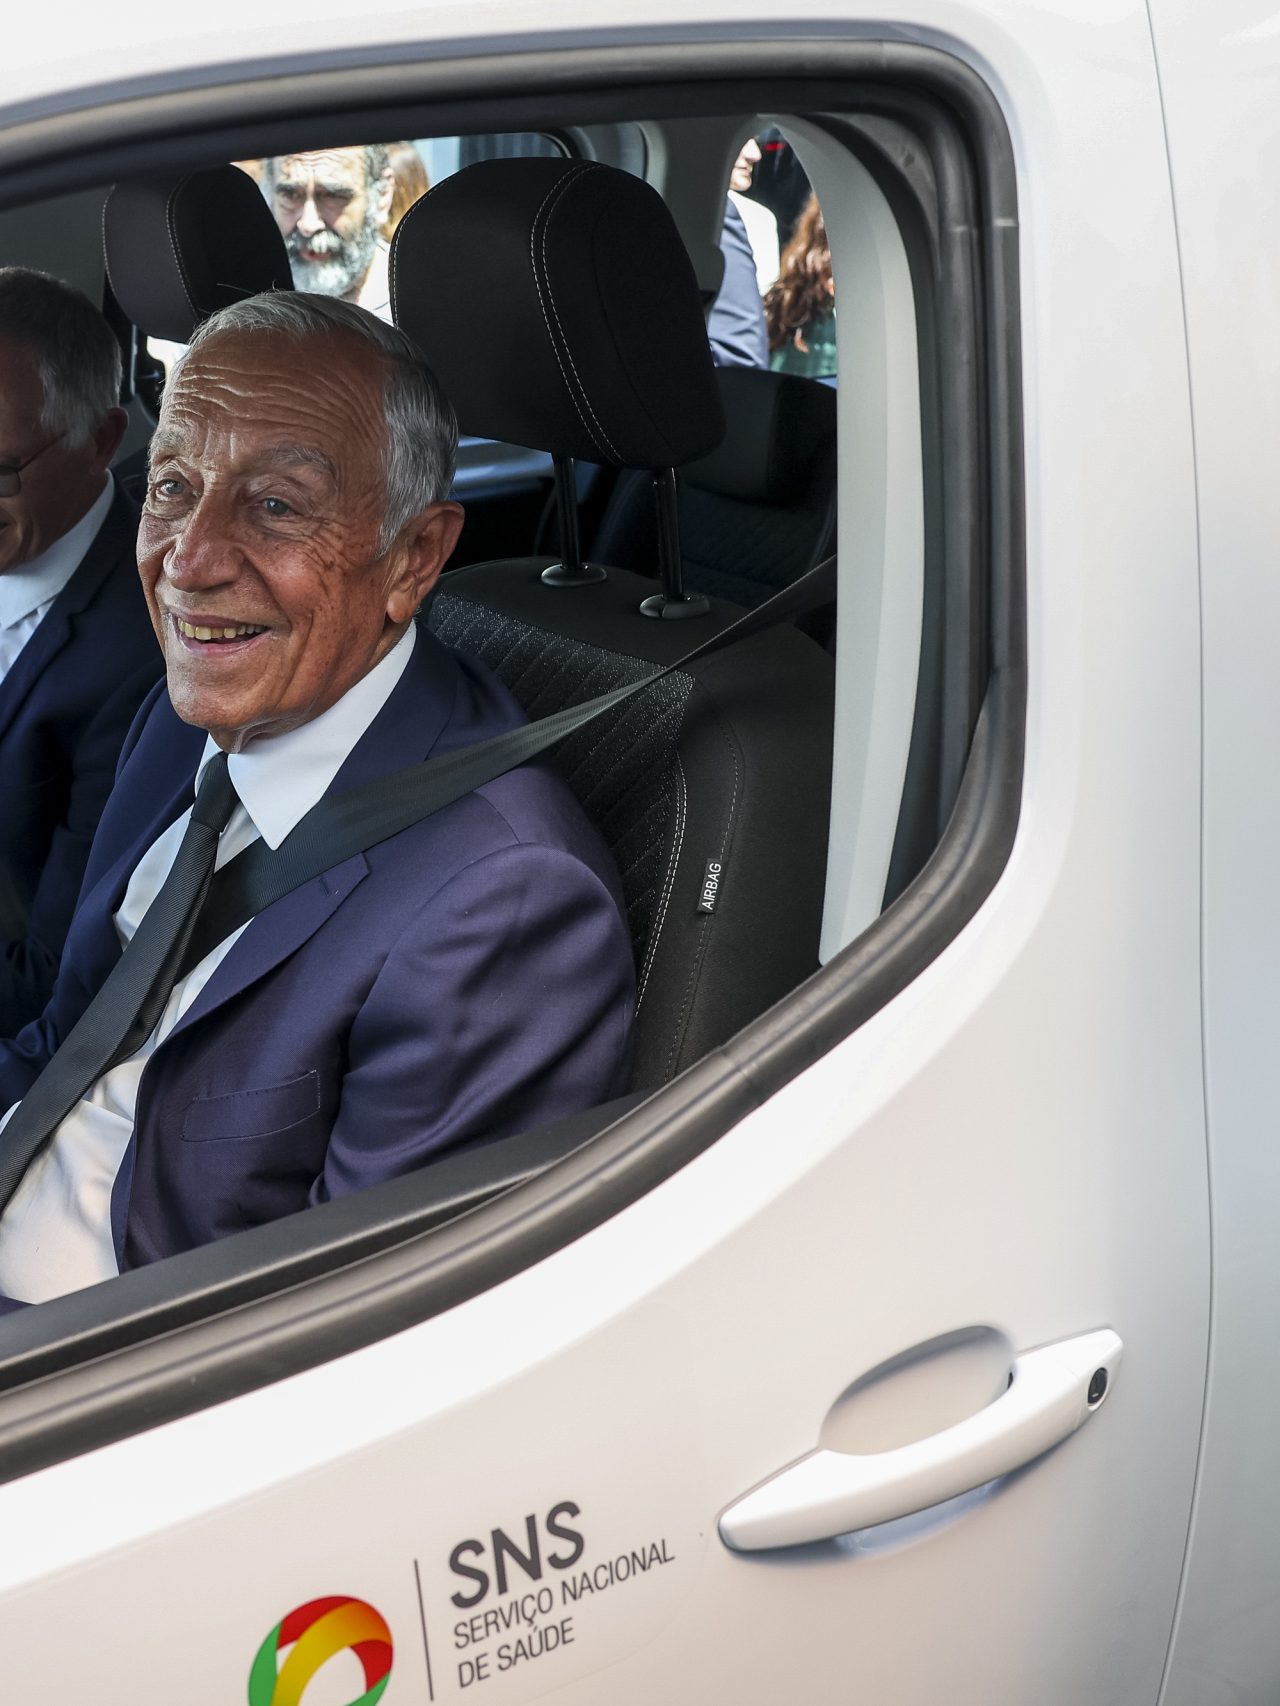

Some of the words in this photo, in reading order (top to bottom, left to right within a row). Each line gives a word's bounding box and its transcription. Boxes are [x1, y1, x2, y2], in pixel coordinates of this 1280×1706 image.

[701, 863, 722, 911] AIRBAG
[449, 1501, 585, 1609] SNS
[453, 1587, 554, 1650] SERVIÇO
[561, 1538, 676, 1606] NACIONAL
[458, 1652, 491, 1689] DE
[496, 1617, 576, 1672] SAÚDE
